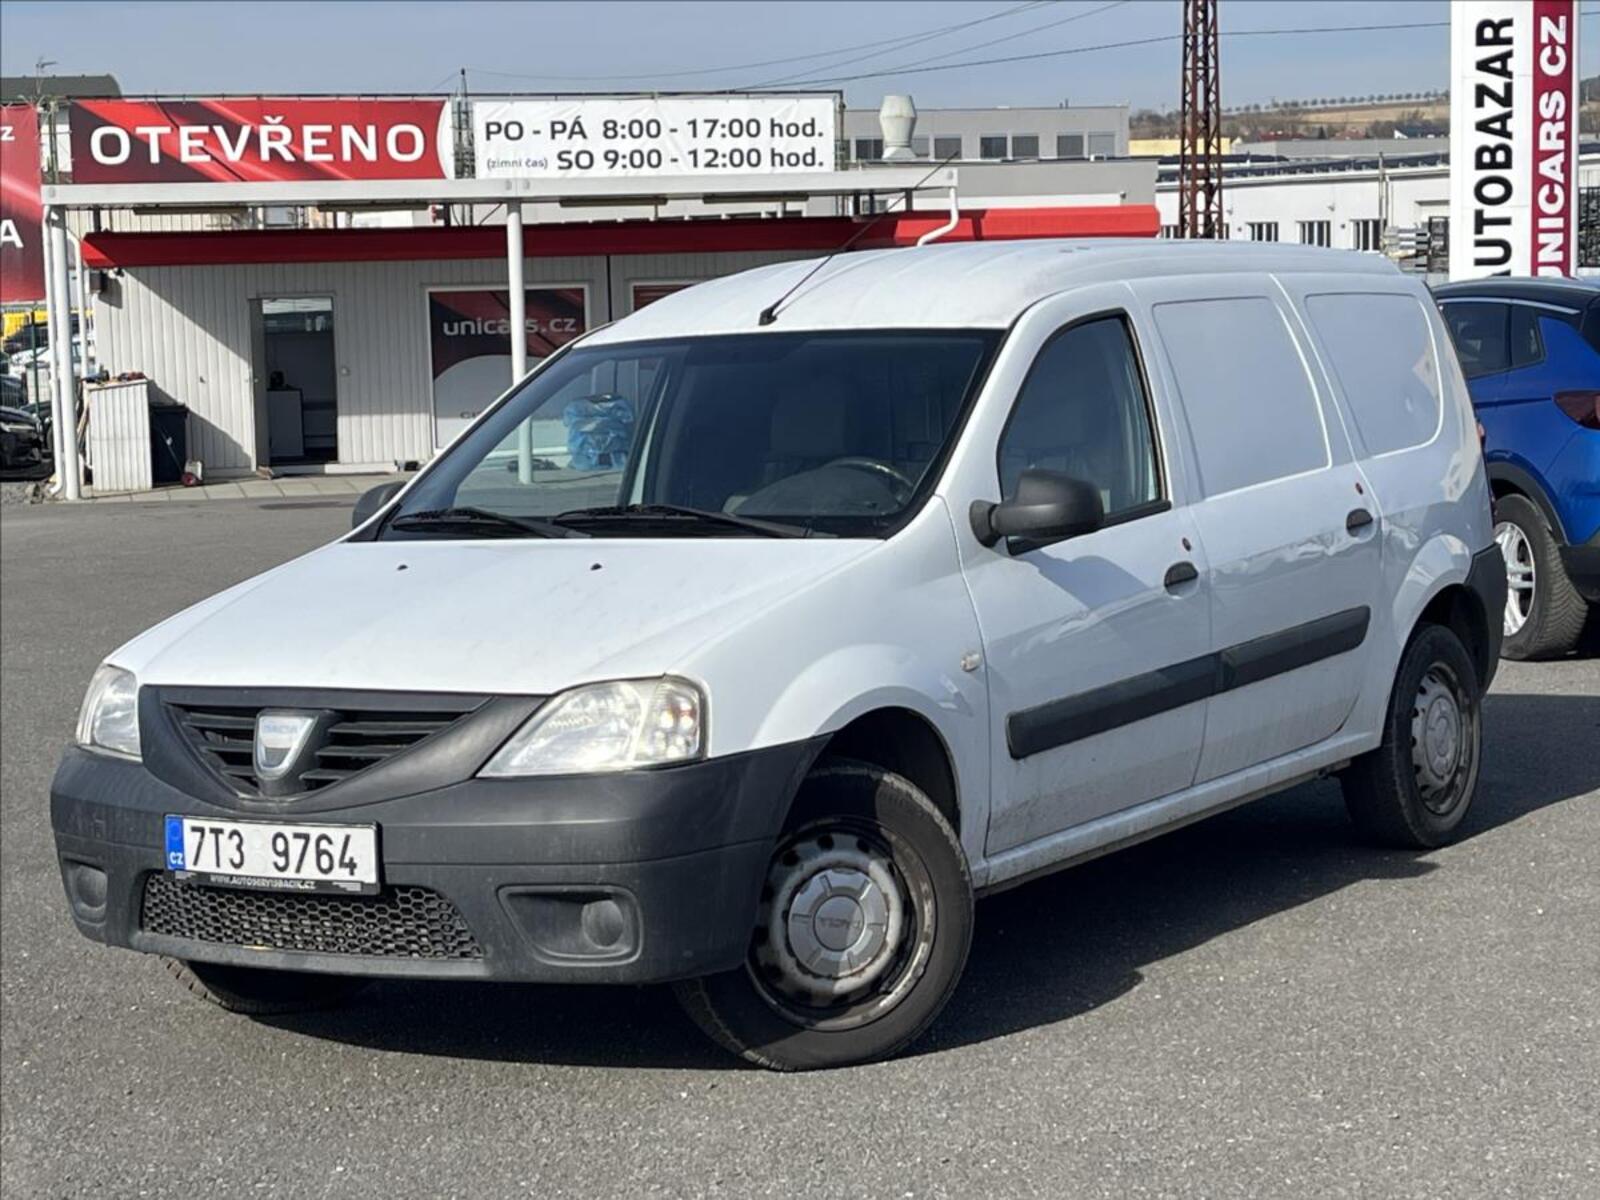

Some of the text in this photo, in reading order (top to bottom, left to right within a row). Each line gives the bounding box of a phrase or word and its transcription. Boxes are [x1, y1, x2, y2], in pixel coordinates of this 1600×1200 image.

[1539, 15, 1567, 76] CZ
[90, 115, 426, 165] OTEVŘENO
[485, 120, 524, 142] PO
[550, 115, 588, 140] PÁ
[602, 118, 662, 139] 8:00
[687, 118, 762, 139] 17:00
[769, 117, 824, 138] hod.
[1474, 18, 1514, 277] UTOBAZAR
[557, 150, 594, 170] SO
[604, 149, 662, 169] 9:00
[687, 148, 762, 168] 12:00
[769, 147, 824, 167] hod.
[443, 316, 577, 336] unicas.cz
[169, 852, 184, 865] CZ
[190, 826, 357, 876] 7T3 9764
